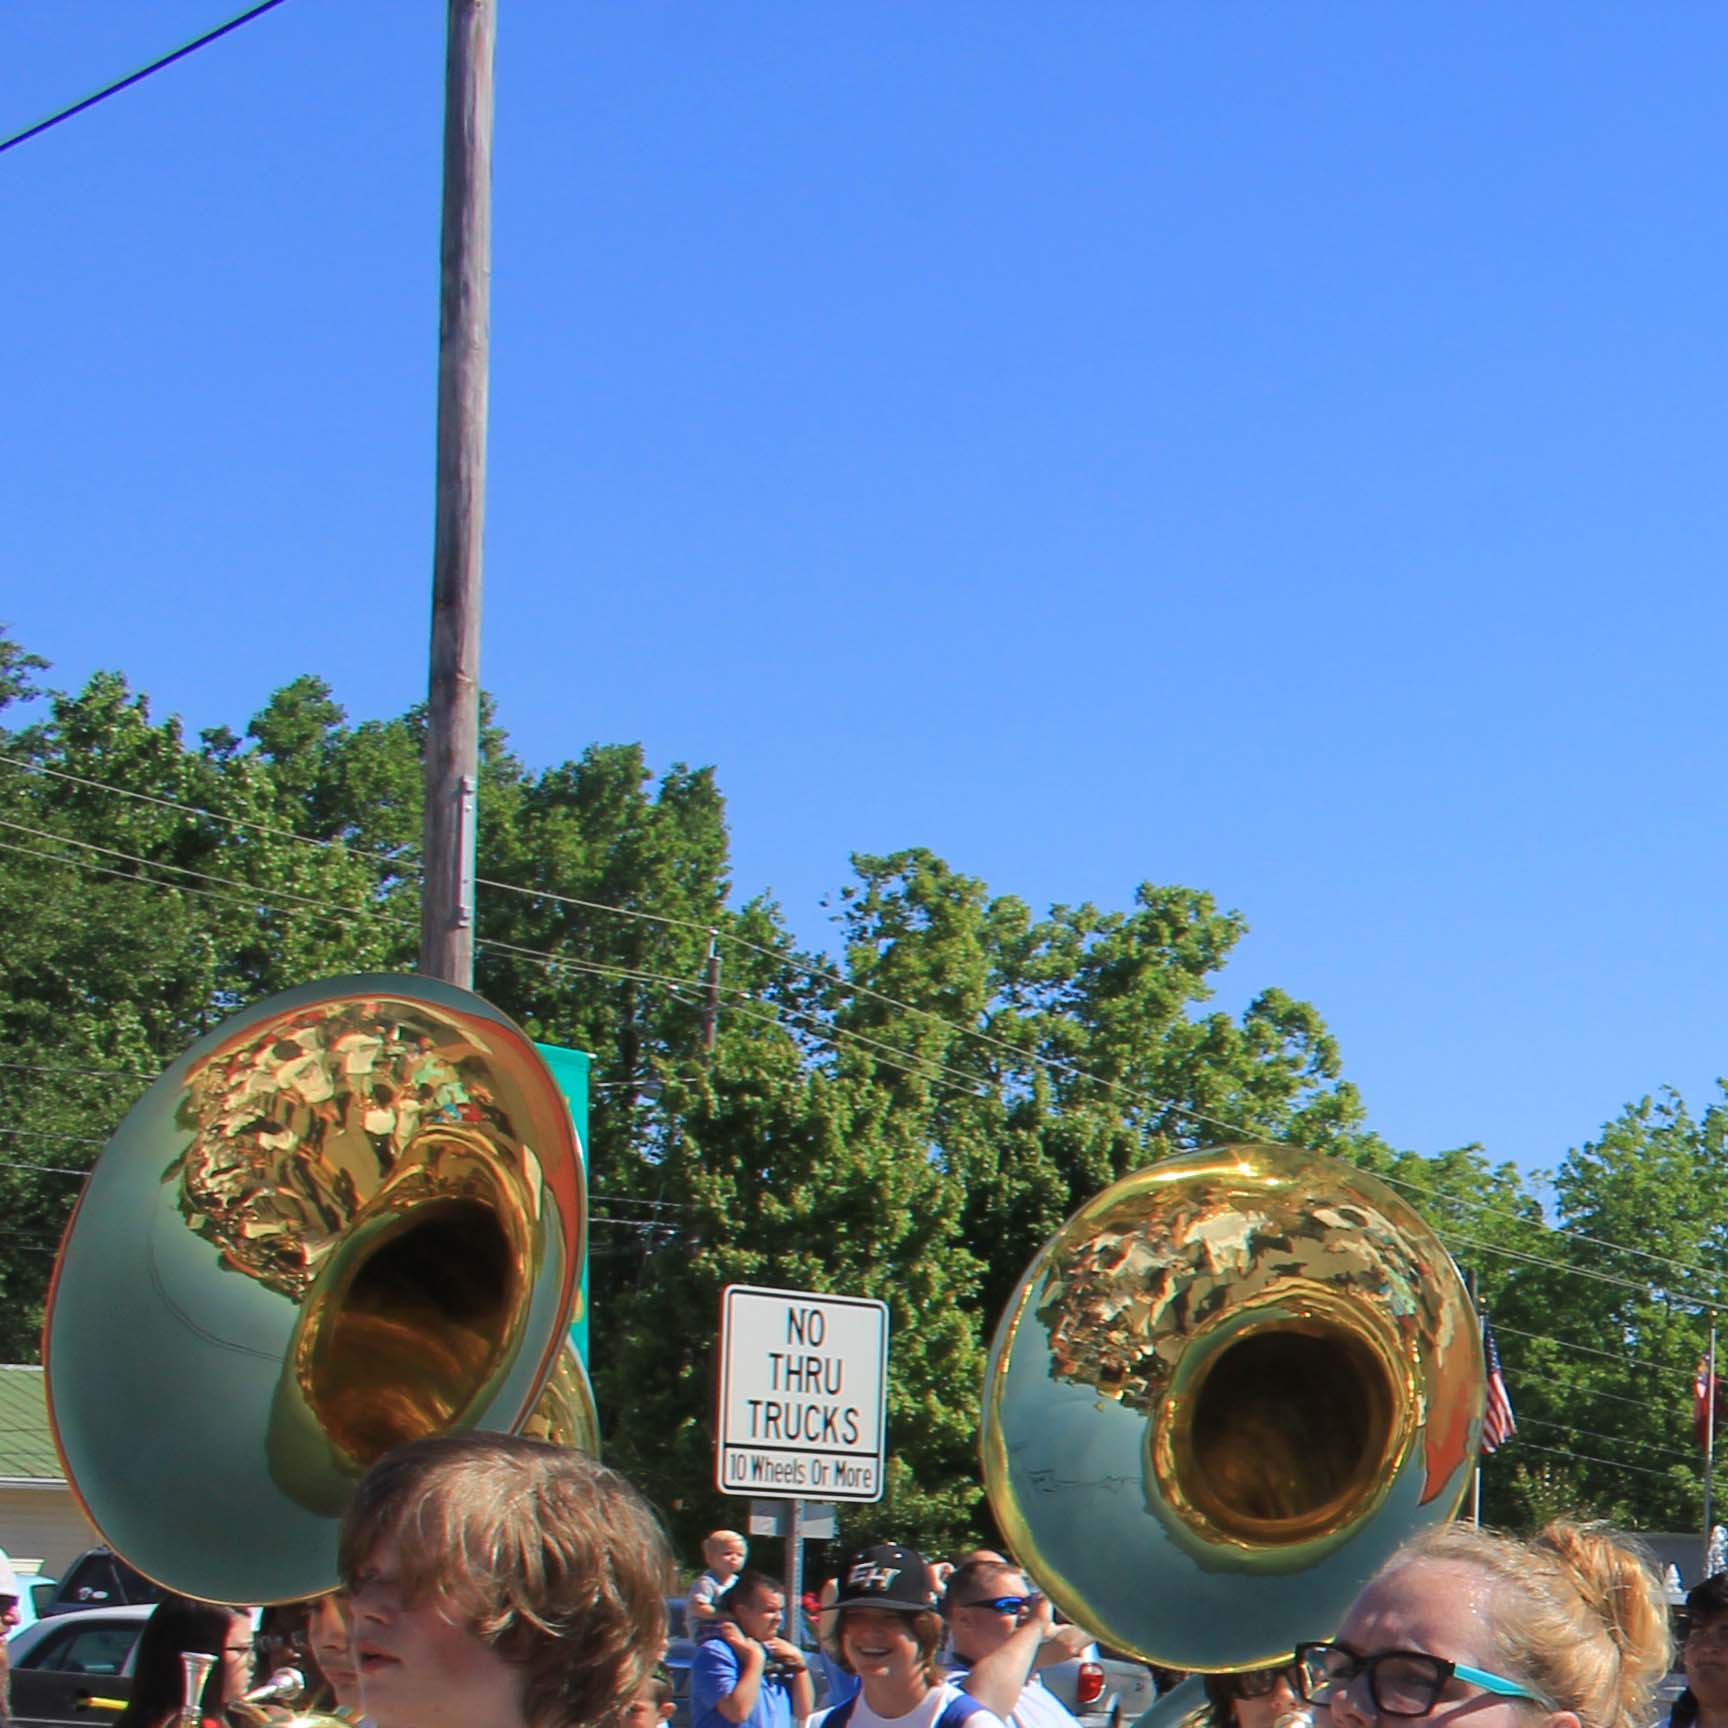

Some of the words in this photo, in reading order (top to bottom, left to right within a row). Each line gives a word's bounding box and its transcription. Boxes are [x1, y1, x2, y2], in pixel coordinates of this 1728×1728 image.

[788, 1307, 826, 1347] NO
[769, 1353, 844, 1395] THRU
[748, 1400, 860, 1444] TRUCKS
[730, 1454, 747, 1481] 10
[751, 1454, 807, 1485] Wheels
[811, 1458, 830, 1487] Or
[834, 1460, 873, 1489] More
